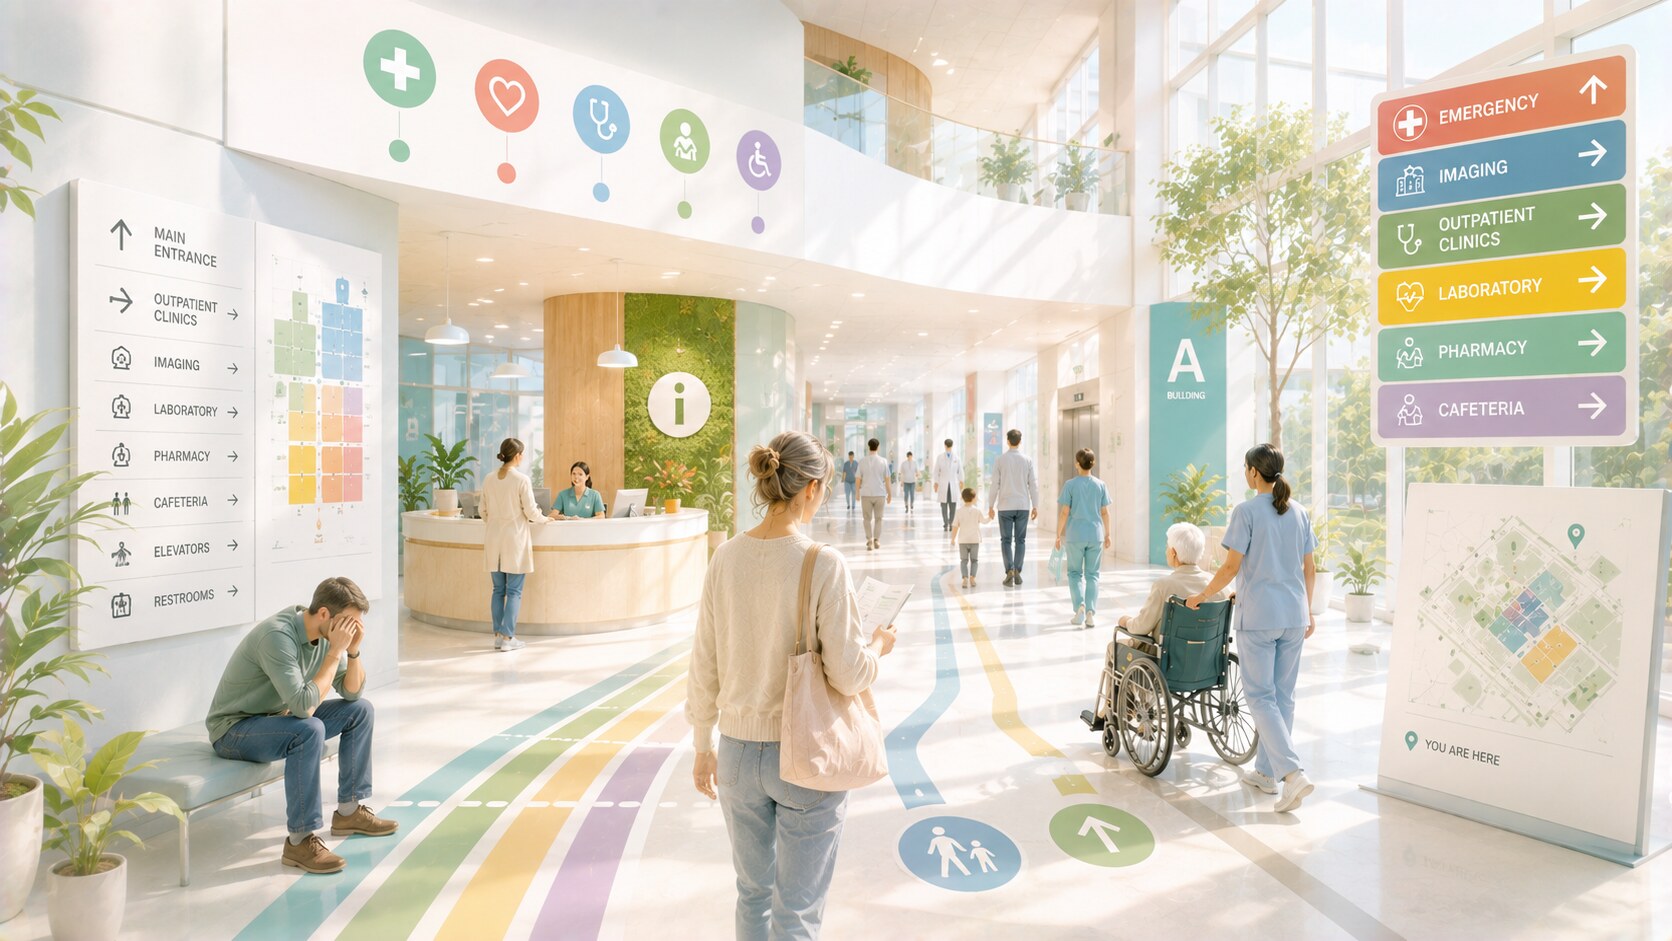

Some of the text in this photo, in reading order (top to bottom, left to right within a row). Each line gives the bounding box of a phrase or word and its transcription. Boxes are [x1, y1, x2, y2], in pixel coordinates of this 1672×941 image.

[1439, 92, 1539, 124] EMERGENCY
[1439, 160, 1508, 183] IMAGING
[1439, 206, 1536, 232] OUTPATIENT
[154, 226, 186, 245] MAIN
[1439, 231, 1501, 252] CLINICS
[154, 244, 217, 268] ENTRANCE
[1439, 277, 1542, 301] LABORATORY
[154, 293, 218, 313] OUTPATIENT
[154, 309, 198, 326] CLINICS
[1439, 340, 1528, 359] PHARMACY
[154, 356, 200, 371] IMAGING
[1167, 338, 1206, 382] A
[1167, 391, 1206, 400] BUILDING
[154, 403, 218, 417] LABORATORY
[1439, 401, 1525, 417] CAFETERIA
[154, 450, 210, 462] PHARMACY
[154, 496, 208, 509] CAFETERIA
[154, 542, 210, 557] ELEVATORS
[154, 588, 214, 607] RESTROOMS
[1425, 739, 1500, 766] YOU ARE HERE
